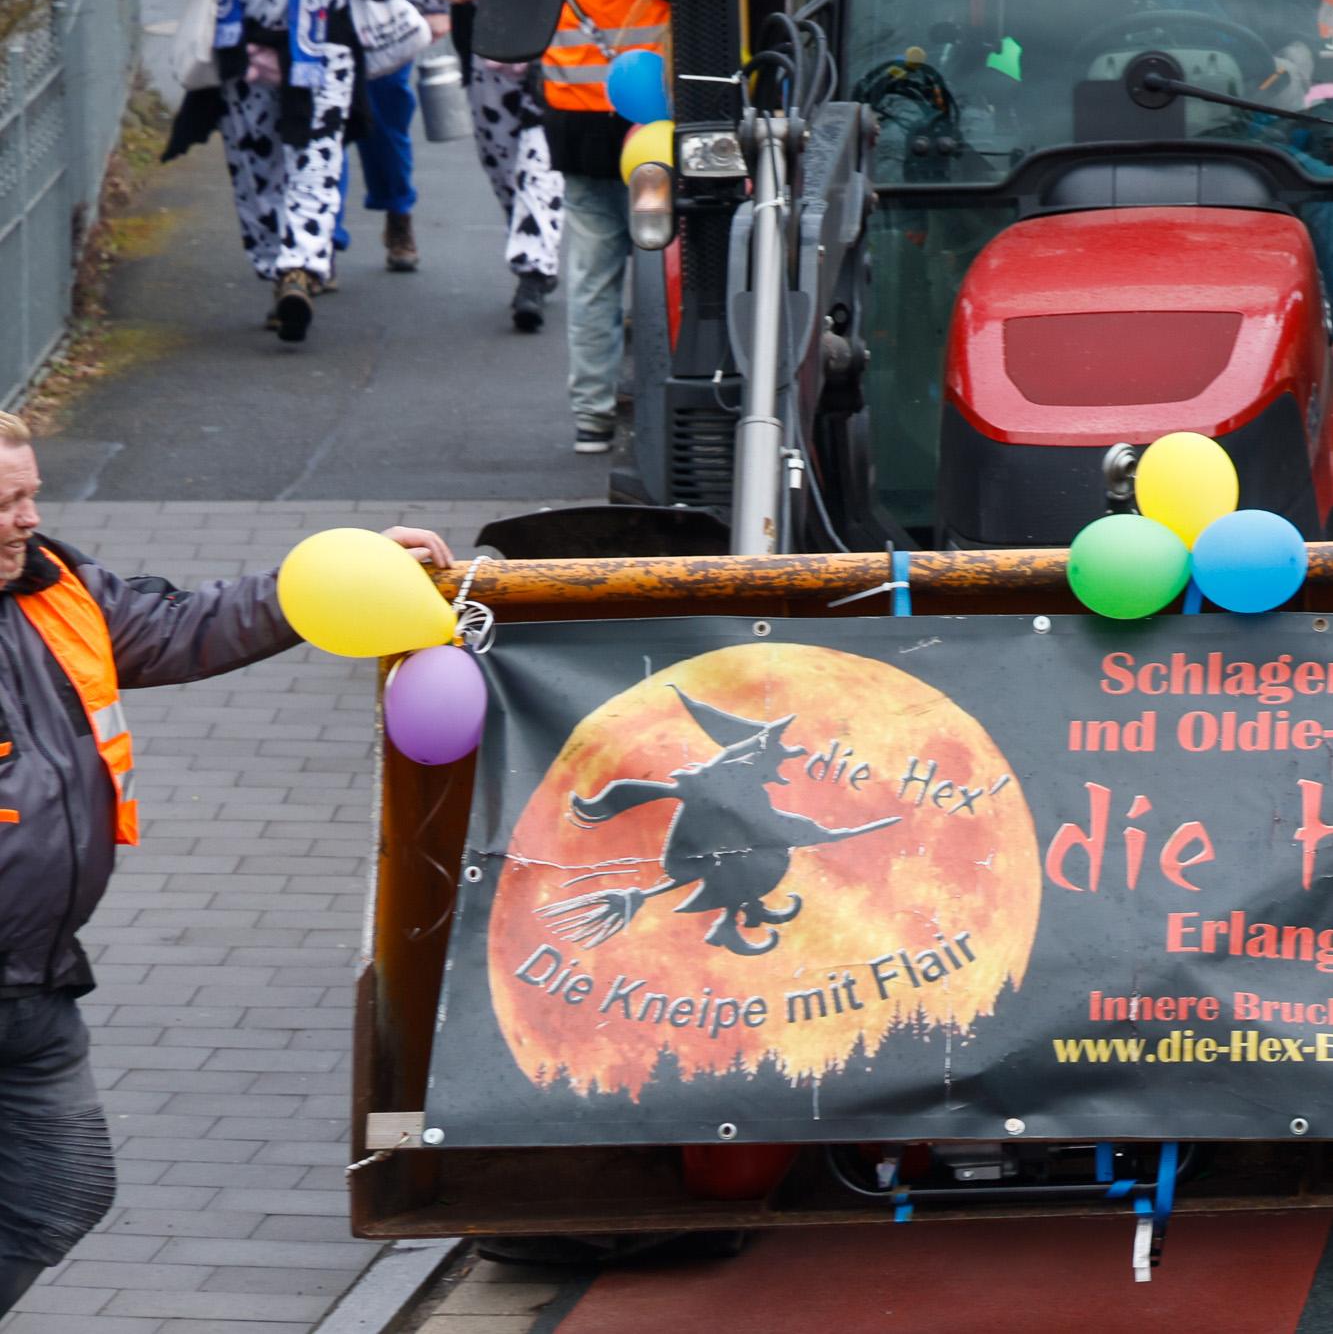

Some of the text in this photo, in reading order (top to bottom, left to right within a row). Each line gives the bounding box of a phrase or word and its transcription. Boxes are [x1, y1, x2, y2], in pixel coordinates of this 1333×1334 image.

[804, 739, 871, 791] die
[1046, 782, 1215, 892] die
[514, 929, 977, 1039] Die Kneipe mit Flair
[1089, 991, 1220, 1021] Innere
